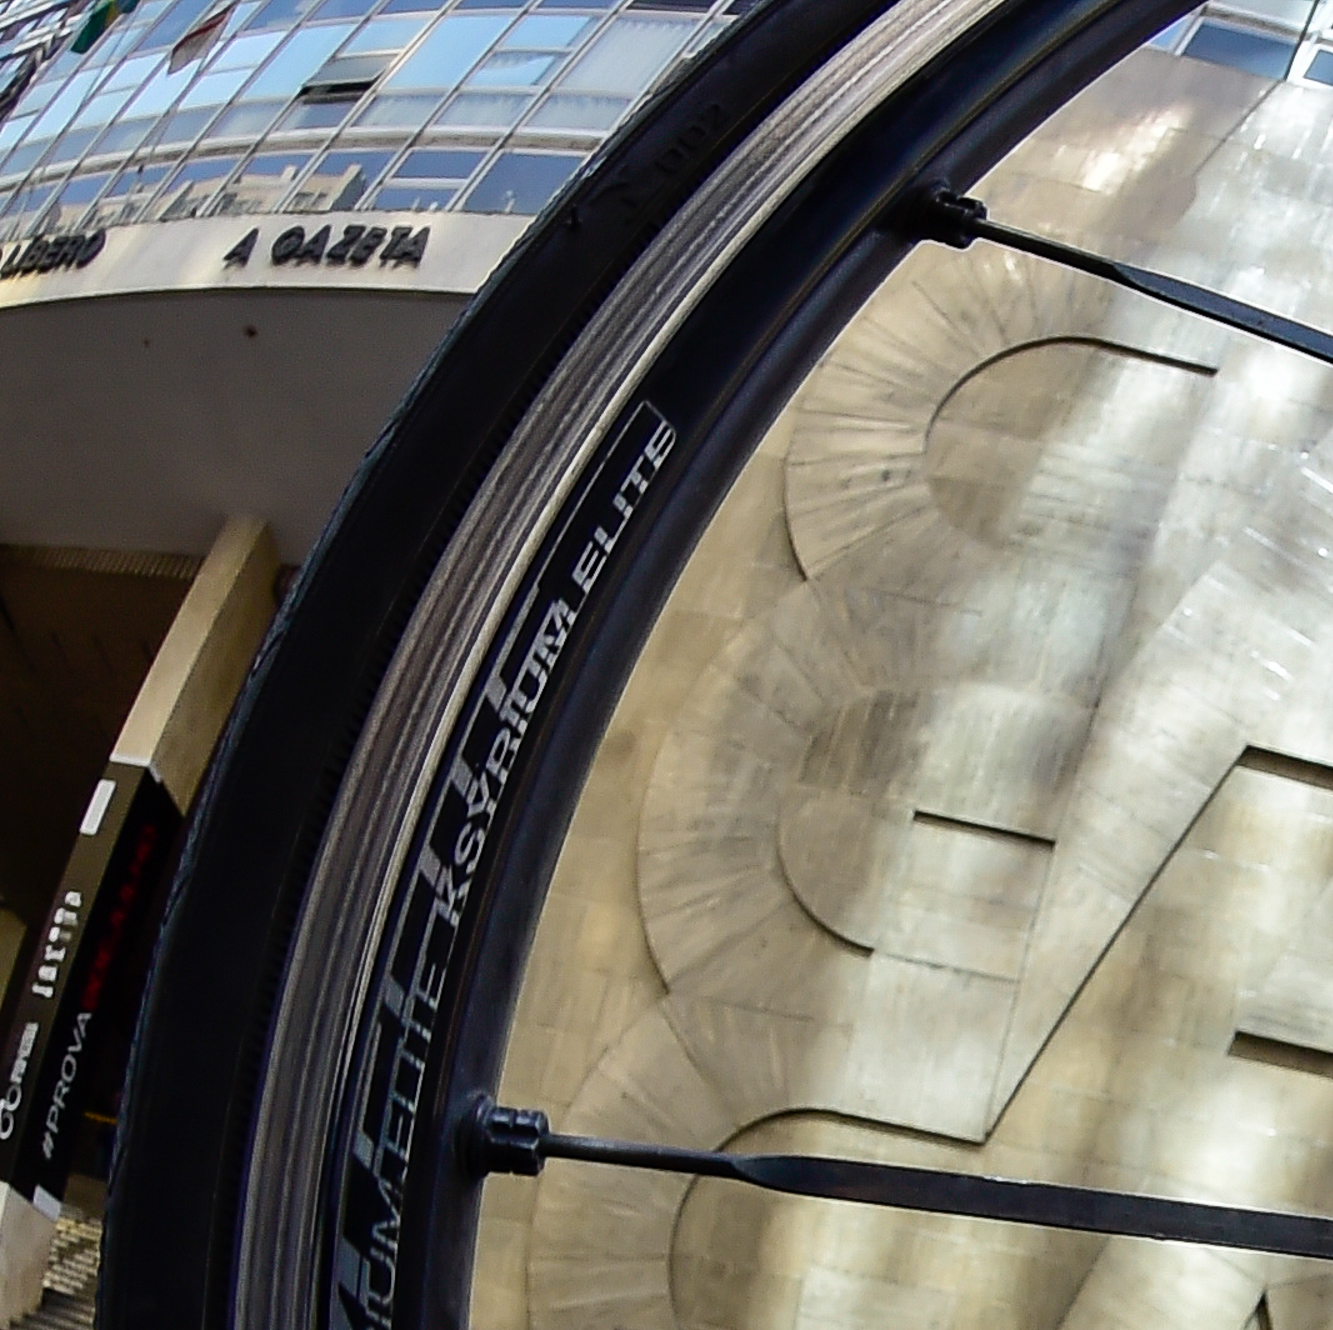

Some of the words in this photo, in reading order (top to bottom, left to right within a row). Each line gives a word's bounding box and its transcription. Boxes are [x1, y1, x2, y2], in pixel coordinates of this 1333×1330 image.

[222, 227, 260, 270] A
[271, 224, 431, 269] GAZETA
[433, 598, 580, 930] KSYRIUM
[571, 418, 677, 596] ELITE
